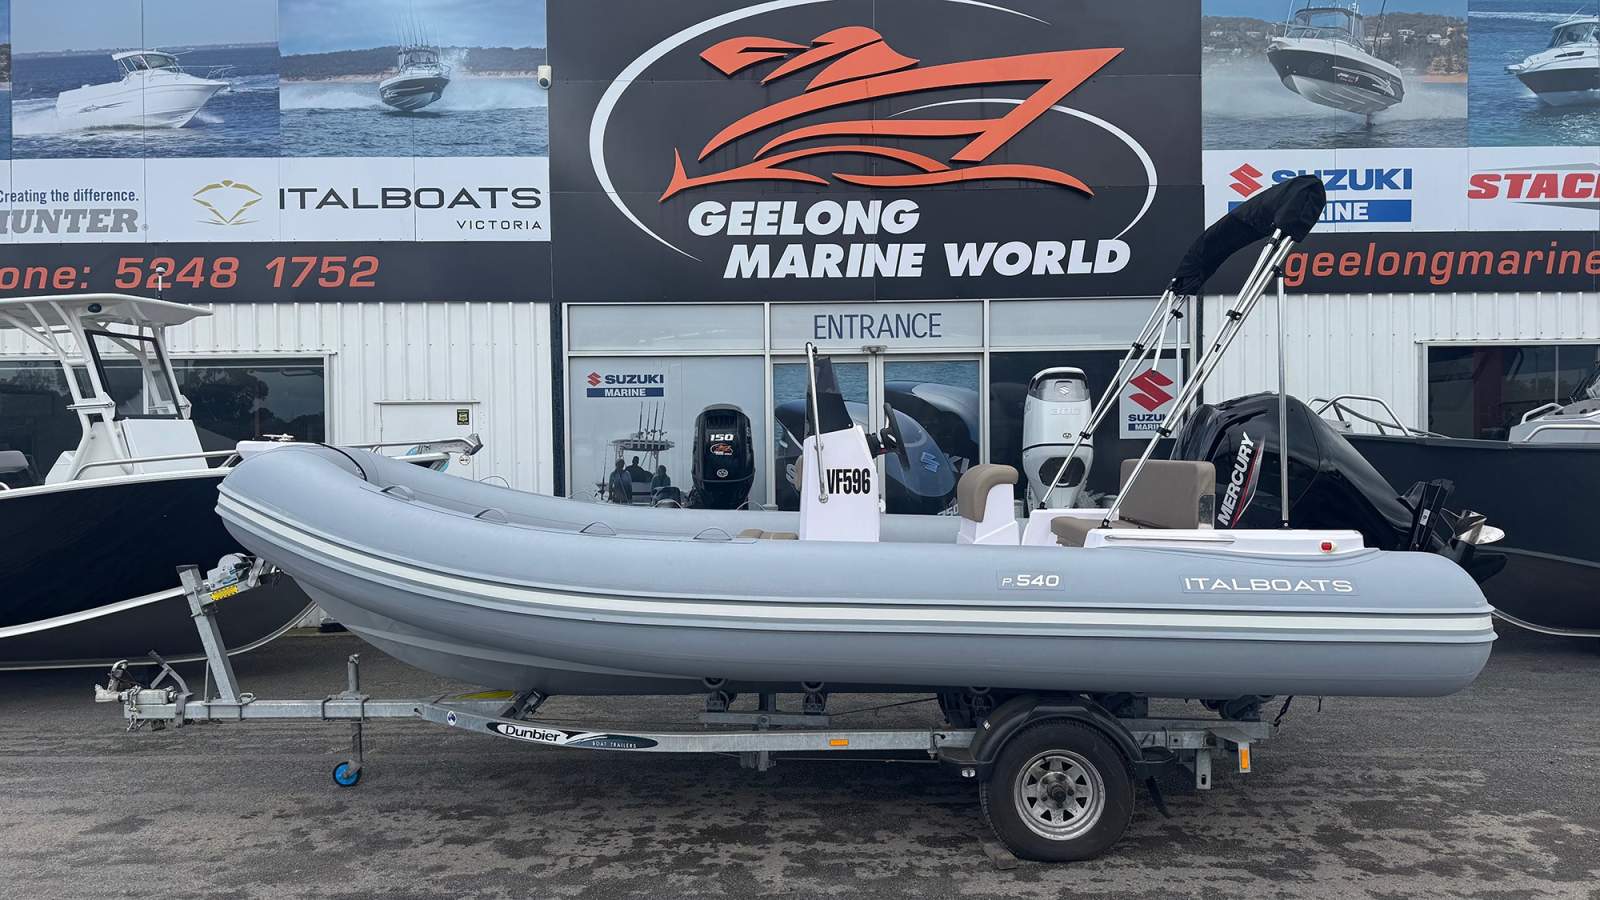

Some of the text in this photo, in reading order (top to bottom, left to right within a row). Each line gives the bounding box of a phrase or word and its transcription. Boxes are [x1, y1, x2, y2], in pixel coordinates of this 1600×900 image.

[51, 188, 69, 202] the
[73, 188, 139, 202] difference.
[1467, 173, 1600, 199] STAC
[279, 187, 542, 210] ITALBOATS
[456, 220, 542, 230] VICTORIA
[688, 199, 920, 236] GEELONG
[723, 239, 1131, 279] MARINE WORLD
[1284, 242, 1600, 287] geelongmarine
[114, 256, 240, 289] 5248
[265, 255, 379, 288] 1752
[814, 313, 942, 340] ENTRANCE
[604, 374, 664, 384] SUZUKI
[604, 388, 647, 397] MARINE
[1127, 414, 1167, 422] SUZU
[1135, 423, 1162, 431] MARIN
[710, 433, 733, 441] 150
[826, 468, 871, 495] VF596
[1217, 431, 1254, 526] MERCURY
[1183, 577, 1354, 593] ITALBOATS
[505, 725, 561, 742] Dunbier
